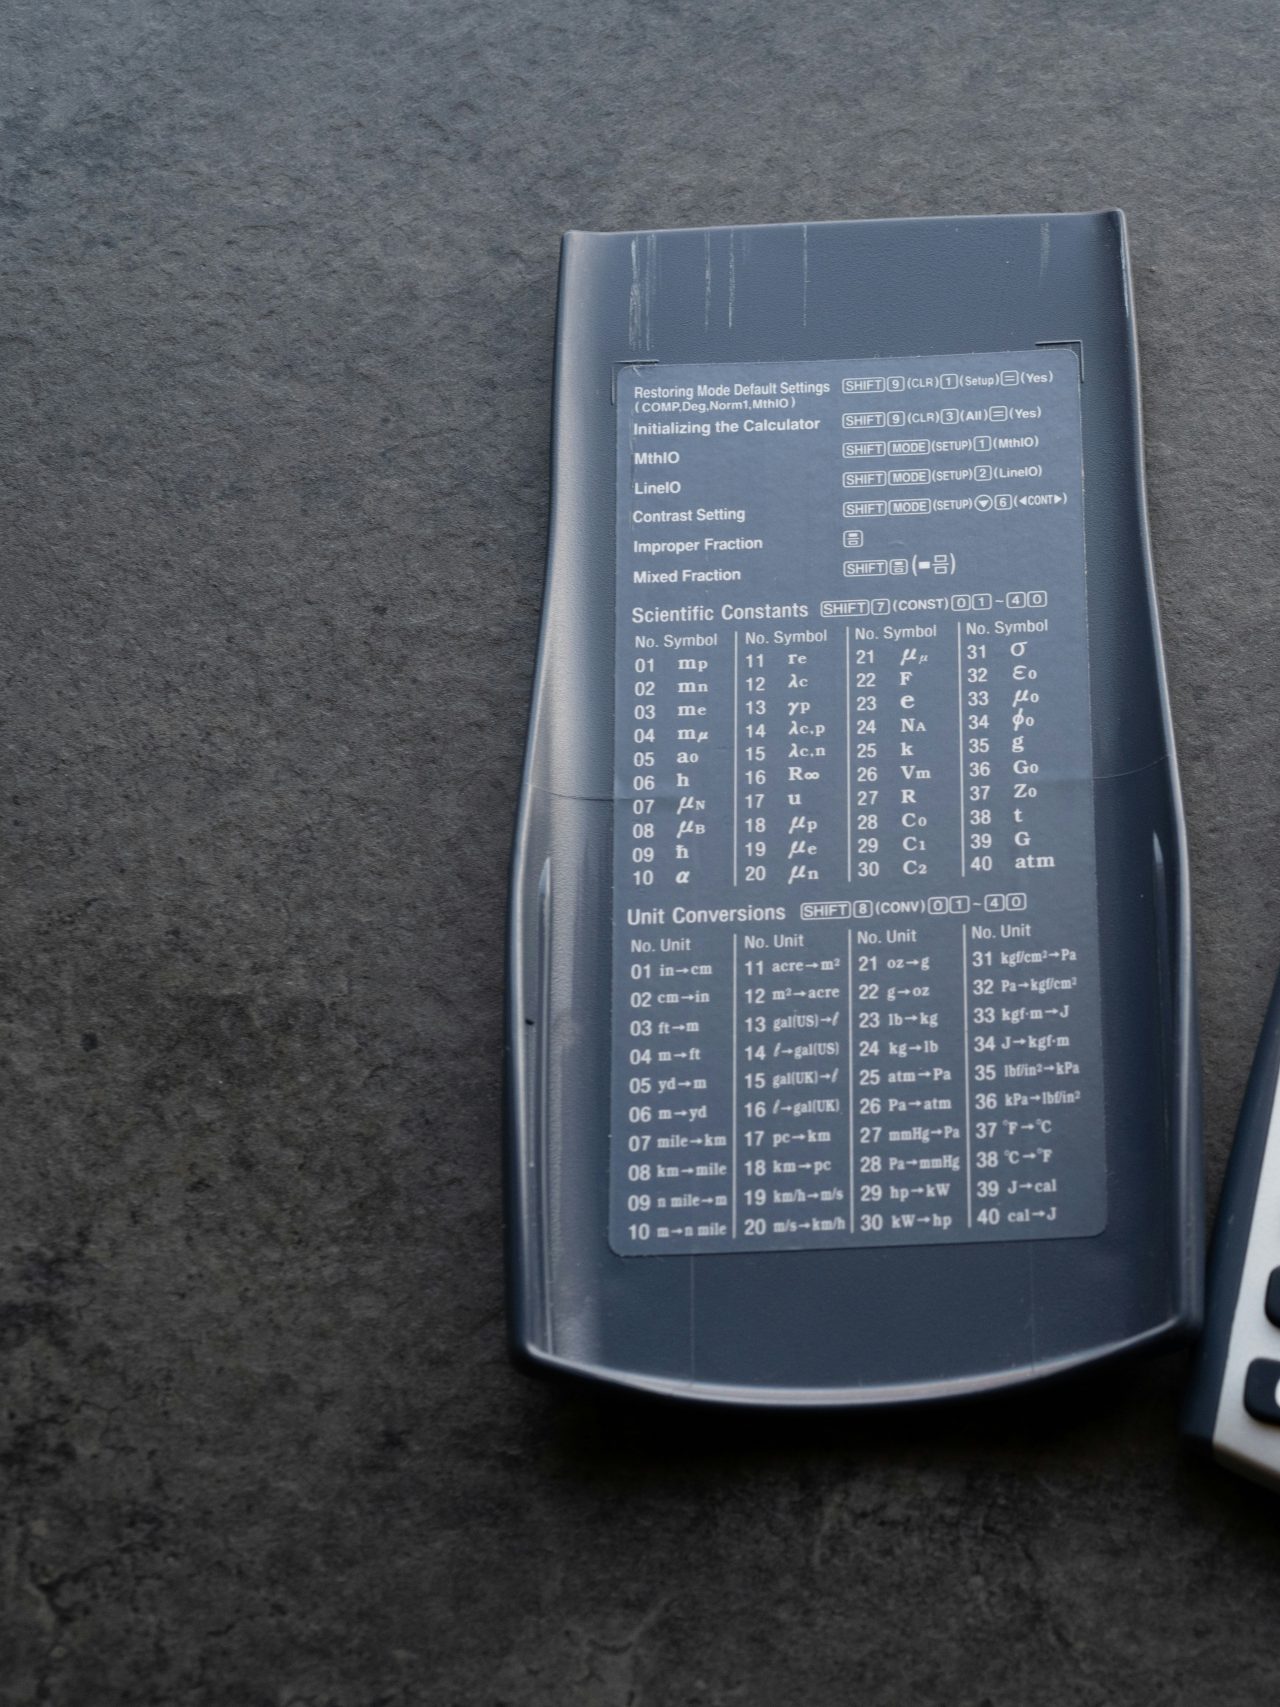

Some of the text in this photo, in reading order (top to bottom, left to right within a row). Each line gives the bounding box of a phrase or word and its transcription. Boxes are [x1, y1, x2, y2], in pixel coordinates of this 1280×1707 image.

[635, 382, 830, 400] Restoring Mode Default Settings
[845, 379, 883, 392] SHIFT
[845, 413, 883, 426] SHIFT
[634, 419, 820, 436] Initializing the Calculator
[845, 444, 884, 456] SHIFT
[892, 442, 927, 453] MODE
[635, 452, 679, 464] MthIO
[845, 474, 884, 486] SHIFT
[892, 471, 928, 483] MODE
[635, 481, 681, 494] LineIO
[633, 508, 745, 523] Contrast Setting
[845, 502, 884, 516] SHIFT
[893, 500, 928, 513] MODE
[634, 537, 763, 555] Improper Fraction
[847, 562, 884, 574] SHIFT
[634, 569, 741, 583] Mixed Fraction
[632, 603, 808, 623] Scientific Constants
[823, 602, 866, 615] SHIFT
[855, 625, 936, 641] No. Symbol
[967, 619, 1048, 636] No. Symbol
[635, 633, 717, 649] No. Symbol
[746, 629, 827, 645] No. Symbol
[635, 658, 708, 672] 01 mp
[746, 654, 806, 668] 11 re
[635, 682, 708, 696] 02 mn
[635, 705, 706, 719] 03 me
[857, 720, 876, 734] 24
[858, 765, 930, 781] 26 Vm
[971, 855, 1055, 871] 40 atm
[628, 905, 785, 925] Unit Conversions
[804, 904, 848, 917] SHIFT
[858, 929, 916, 944] No. Unit
[972, 924, 1031, 939] No. Unit
[631, 938, 690, 952] No. Unit
[745, 934, 803, 948] No. Unit
[631, 964, 650, 979] 01
[977, 1208, 1000, 1224] 40
